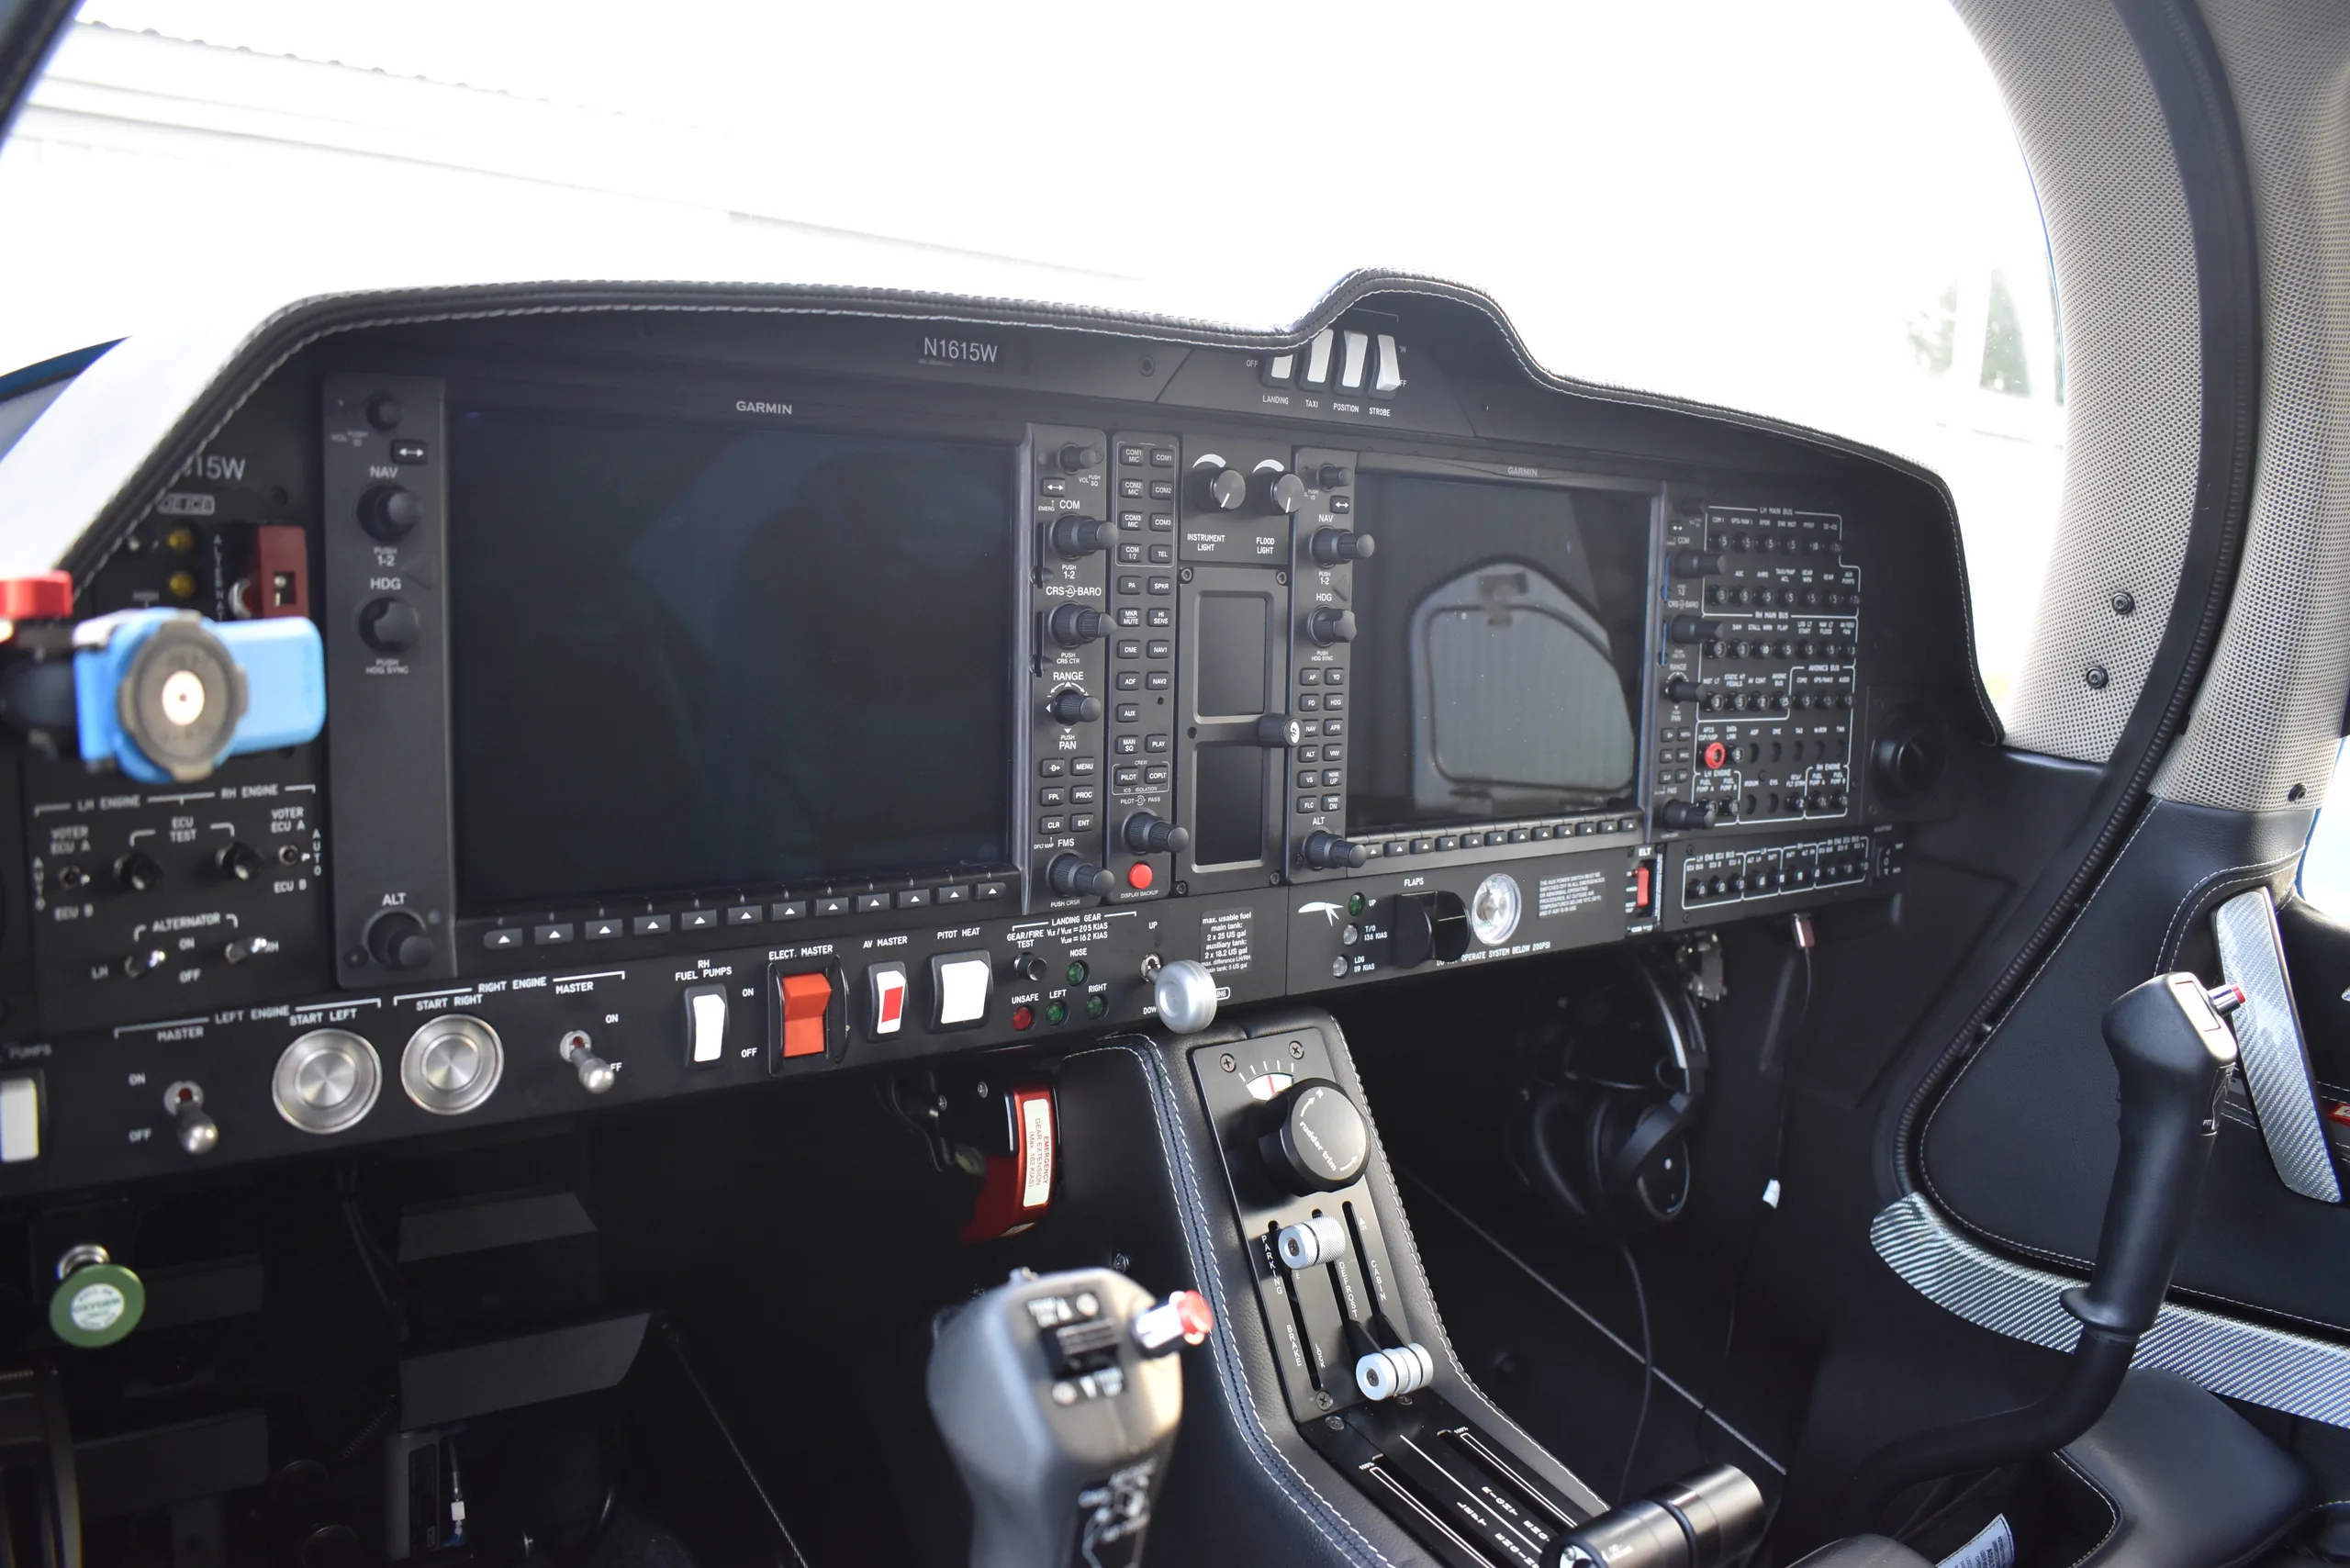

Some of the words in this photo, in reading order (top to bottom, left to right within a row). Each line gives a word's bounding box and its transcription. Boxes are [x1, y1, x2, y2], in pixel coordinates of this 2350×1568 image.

[923, 337, 998, 363] N1615W
[1262, 396, 1289, 405] LANDING
[1305, 399, 1318, 409] TAXI
[735, 400, 792, 415] GARMIN
[1333, 403, 1360, 413] POSITION
[1369, 407, 1391, 417] STROBE
[369, 465, 398, 479] NAV
[1507, 466, 1538, 476] GARMIN
[1059, 499, 1080, 510] COM
[1187, 533, 1225, 543] INSTRUMENT
[1256, 537, 1275, 545] FLOOD
[376, 554, 396, 567] 1-2
[1063, 571, 1075, 579] 1-2
[370, 577, 402, 590] HDG
[1046, 587, 1065, 596] CRS
[1077, 587, 1102, 597] BARO
[1053, 671, 1084, 681] RANGE
[1058, 740, 1077, 750] PAN
[221, 786, 238, 800] RH
[241, 784, 278, 798] ENGINE
[78, 798, 95, 812] LH
[99, 795, 141, 811] ENGINE
[1058, 838, 1075, 847] FMS
[1638, 848, 1651, 856] ELT
[1404, 877, 1424, 887] FLAPS
[382, 892, 407, 906] ALT
[151, 913, 221, 932] ALTERNATOR
[1051, 915, 1081, 927] LANDING
[1083, 913, 1102, 923] GEAR
[1218, 913, 1239, 923] usable
[1148, 921, 1158, 930] UP
[936, 930, 959, 940] PITOT
[961, 927, 980, 938] HEAT
[1006, 929, 1045, 942] GEAR/FIRE
[1057, 927, 1060, 935] /
[1079, 924, 1092, 932] 205
[1093, 922, 1108, 930] KIAS
[1080, 933, 1091, 942] 162
[1092, 931, 1109, 940] KIAS
[1237, 929, 1247, 939] gal
[1376, 931, 1388, 939] KIAS
[863, 939, 874, 949] AV
[877, 935, 908, 948] MASTER
[1017, 939, 1035, 949] TEST
[1205, 941, 1231, 950] auxiliary
[768, 949, 798, 961] ELECT.
[800, 945, 834, 958] MASTER
[1069, 947, 1088, 958] NOSE
[1238, 946, 1248, 957] gal
[1460, 951, 1487, 962] OPERATE
[1488, 947, 1510, 958] SYSTEM
[1511, 945, 1530, 955] BELOW
[1532, 941, 1551, 952] 200PSI
[698, 959, 711, 969] RH
[675, 970, 699, 981] FUEL
[702, 966, 733, 979] PUMPS
[477, 980, 508, 993] RIGHT
[512, 976, 547, 990] ENGINE
[555, 981, 594, 995] MASTER
[1088, 983, 1107, 993] RIGHT
[742, 988, 755, 998] ON
[1011, 992, 1039, 1004] UNSAFE
[1048, 989, 1067, 1000] LEFT
[416, 997, 448, 1012] START
[453, 993, 484, 1007] RIGHT
[214, 1009, 246, 1026] LEFT
[251, 1005, 291, 1022] ENGINE
[1142, 1006, 1158, 1015] DOW
[289, 1011, 322, 1027] START
[328, 1007, 358, 1024] LEFT
[605, 1014, 619, 1024] ON
[157, 1025, 205, 1042] MASTER
[741, 1047, 757, 1058] OFF
[610, 1061, 622, 1072] FF
[129, 1072, 146, 1086] ON
[1315, 1088, 1325, 1099] R
[129, 1128, 152, 1143] OFF
[1299, 1121, 1324, 1151] rudder
[1322, 1150, 1337, 1171] trim
[1261, 1235, 1283, 1295] PARKING
[1371, 1260, 1387, 1301] CABIN
[1338, 1260, 1358, 1317] DEFROST
[1286, 1324, 1303, 1367] BRAKE
[1315, 1343, 1326, 1369] LOCK
[1481, 1485, 1518, 1517] RIGHT
[1457, 1501, 1487, 1527] LEFT
